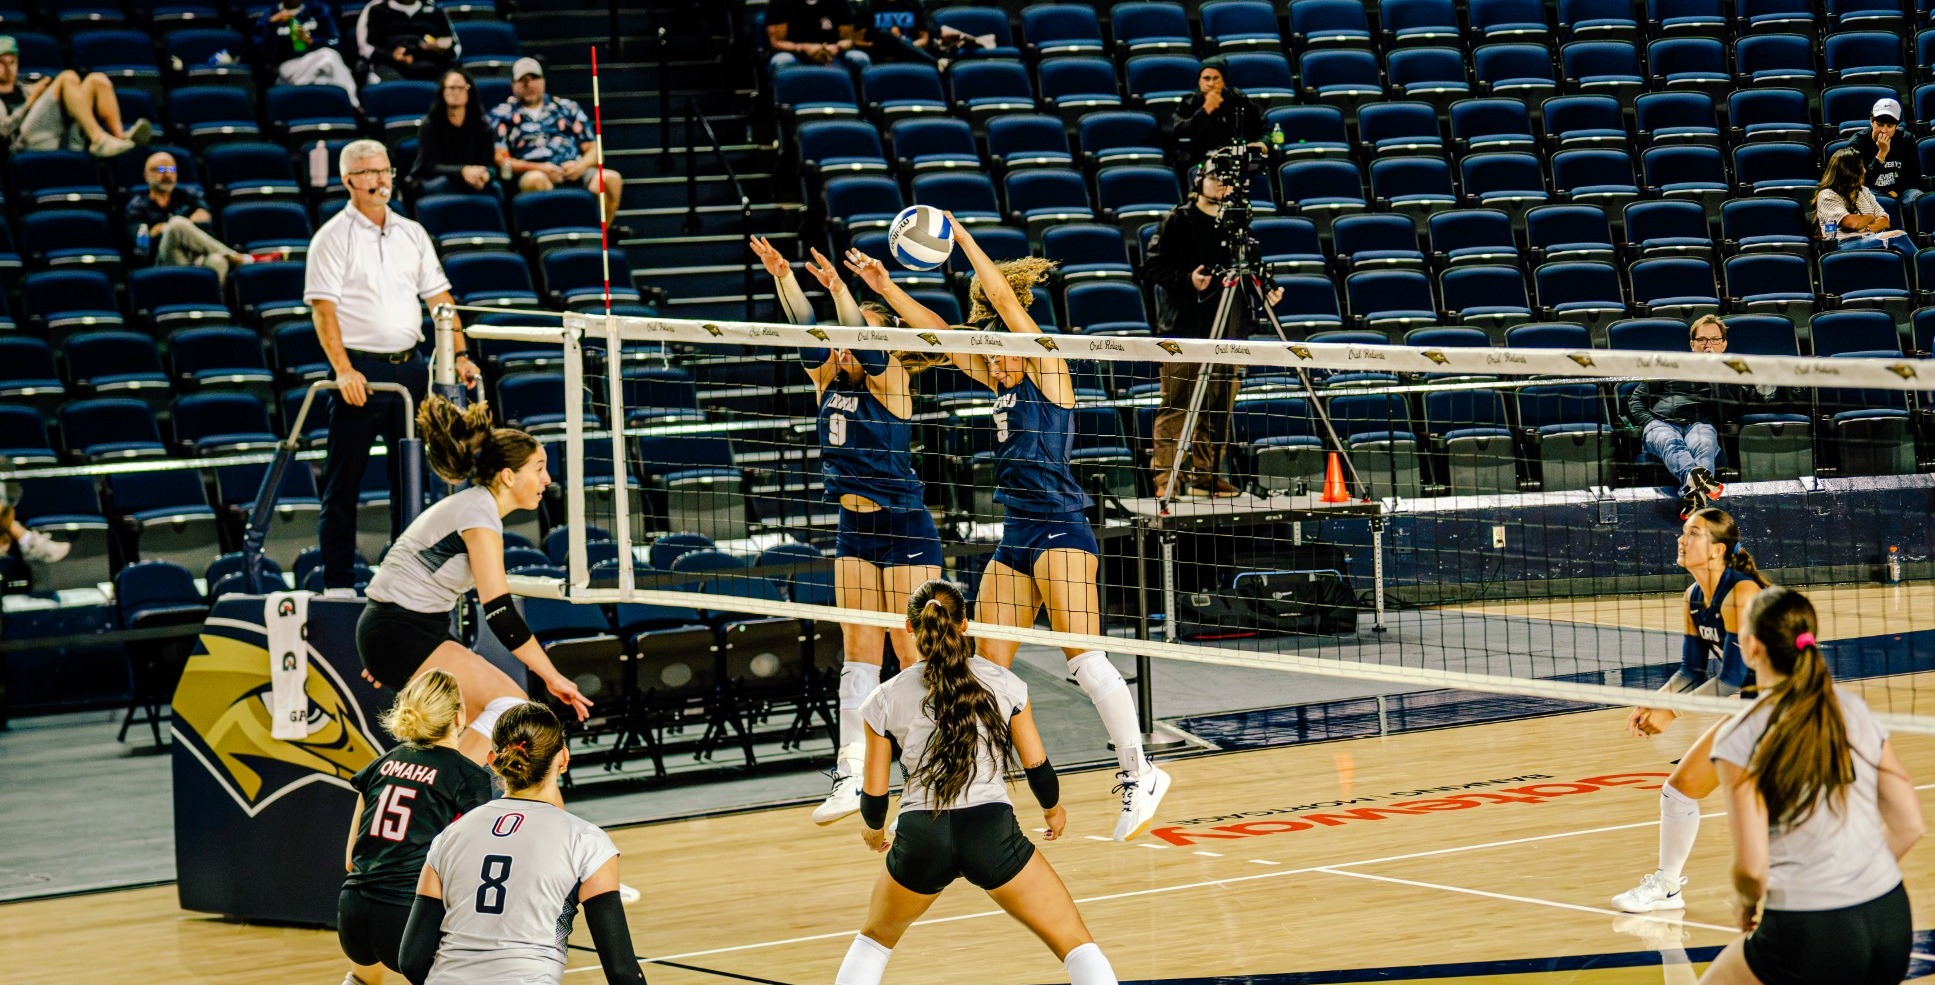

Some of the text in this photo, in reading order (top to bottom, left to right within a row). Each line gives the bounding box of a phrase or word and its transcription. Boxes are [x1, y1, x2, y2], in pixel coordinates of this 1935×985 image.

[890, 218, 910, 250] molten
[1089, 341, 1103, 351] Oral
[1214, 344, 1228, 355] Oral
[828, 412, 847, 447] 9
[379, 760, 438, 786] OMAHA
[369, 783, 419, 843] 15
[1150, 772, 1673, 847] Gateway
[1167, 773, 1554, 826] BANKING MORTGAGE
[474, 853, 514, 915] 8
